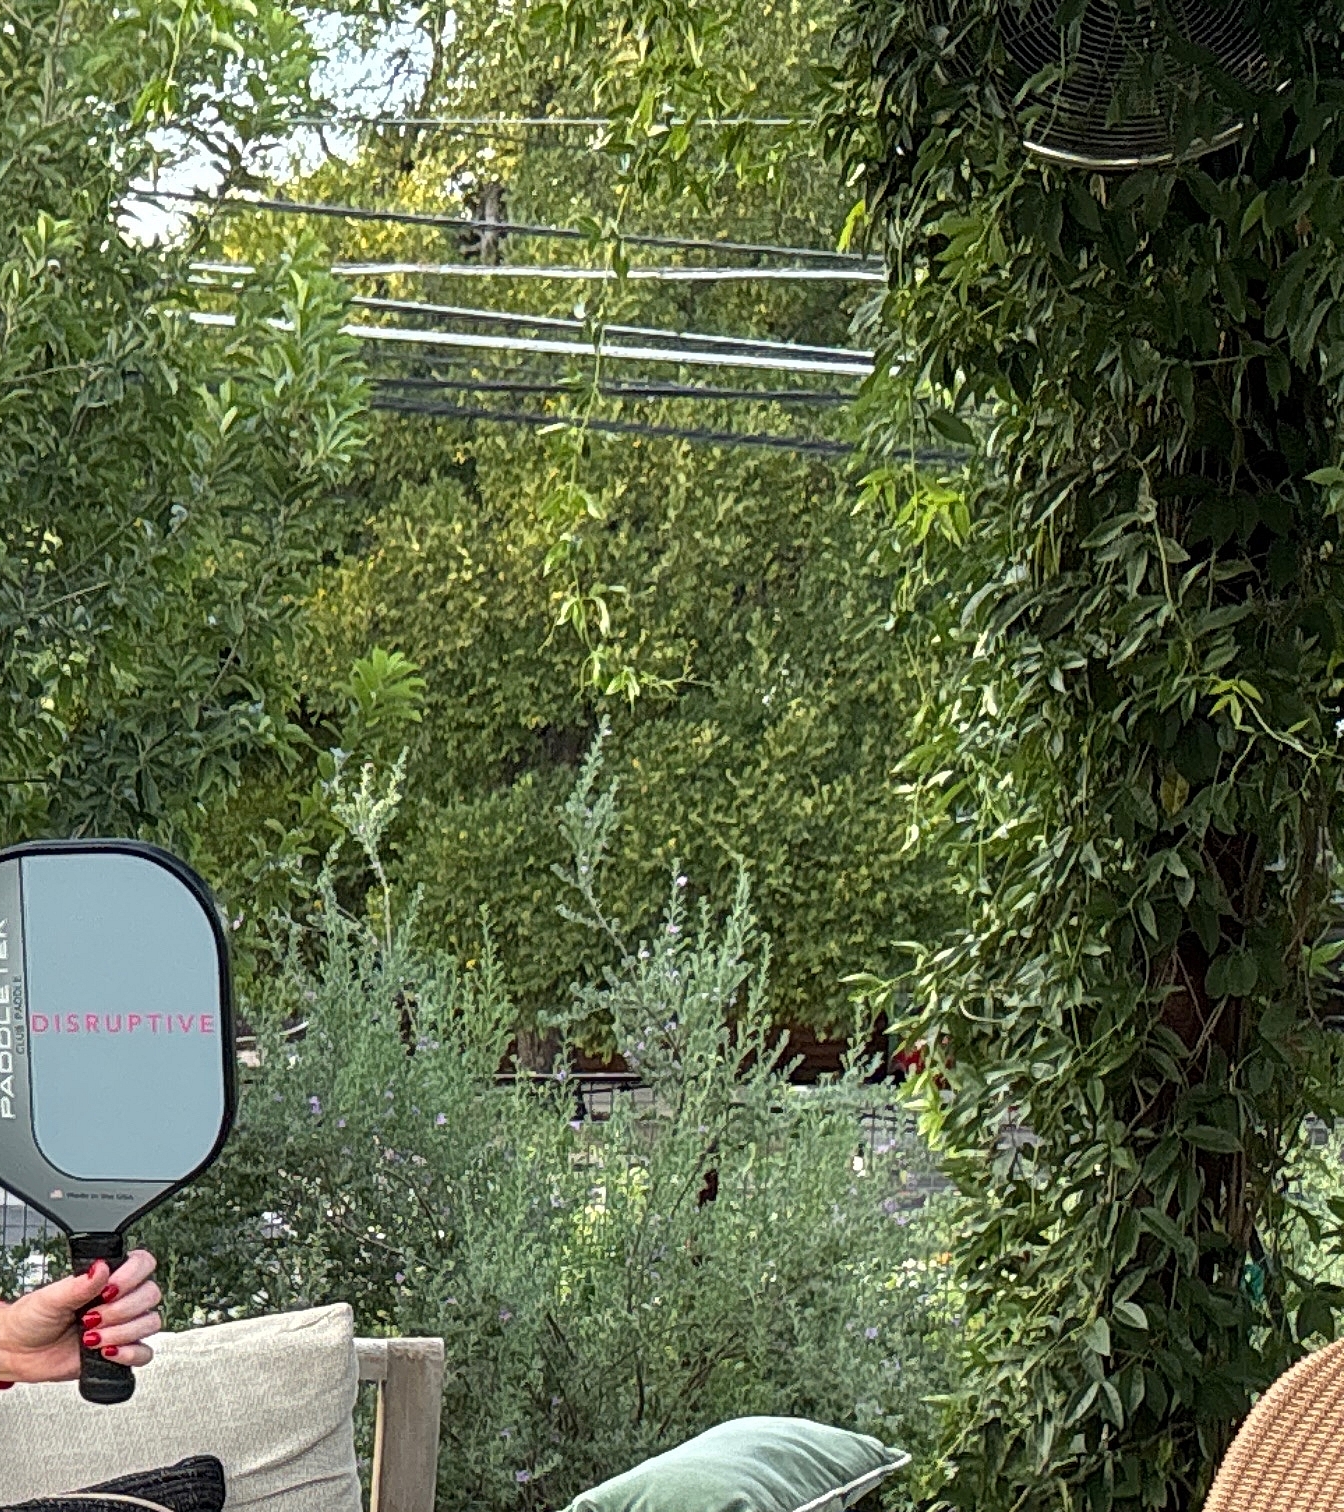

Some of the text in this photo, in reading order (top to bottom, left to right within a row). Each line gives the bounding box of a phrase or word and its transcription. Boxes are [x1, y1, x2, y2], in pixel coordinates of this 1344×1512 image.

[12, 975, 25, 1055] CLUB PADDLE
[31, 1013, 215, 1034] DISRUPTIVE
